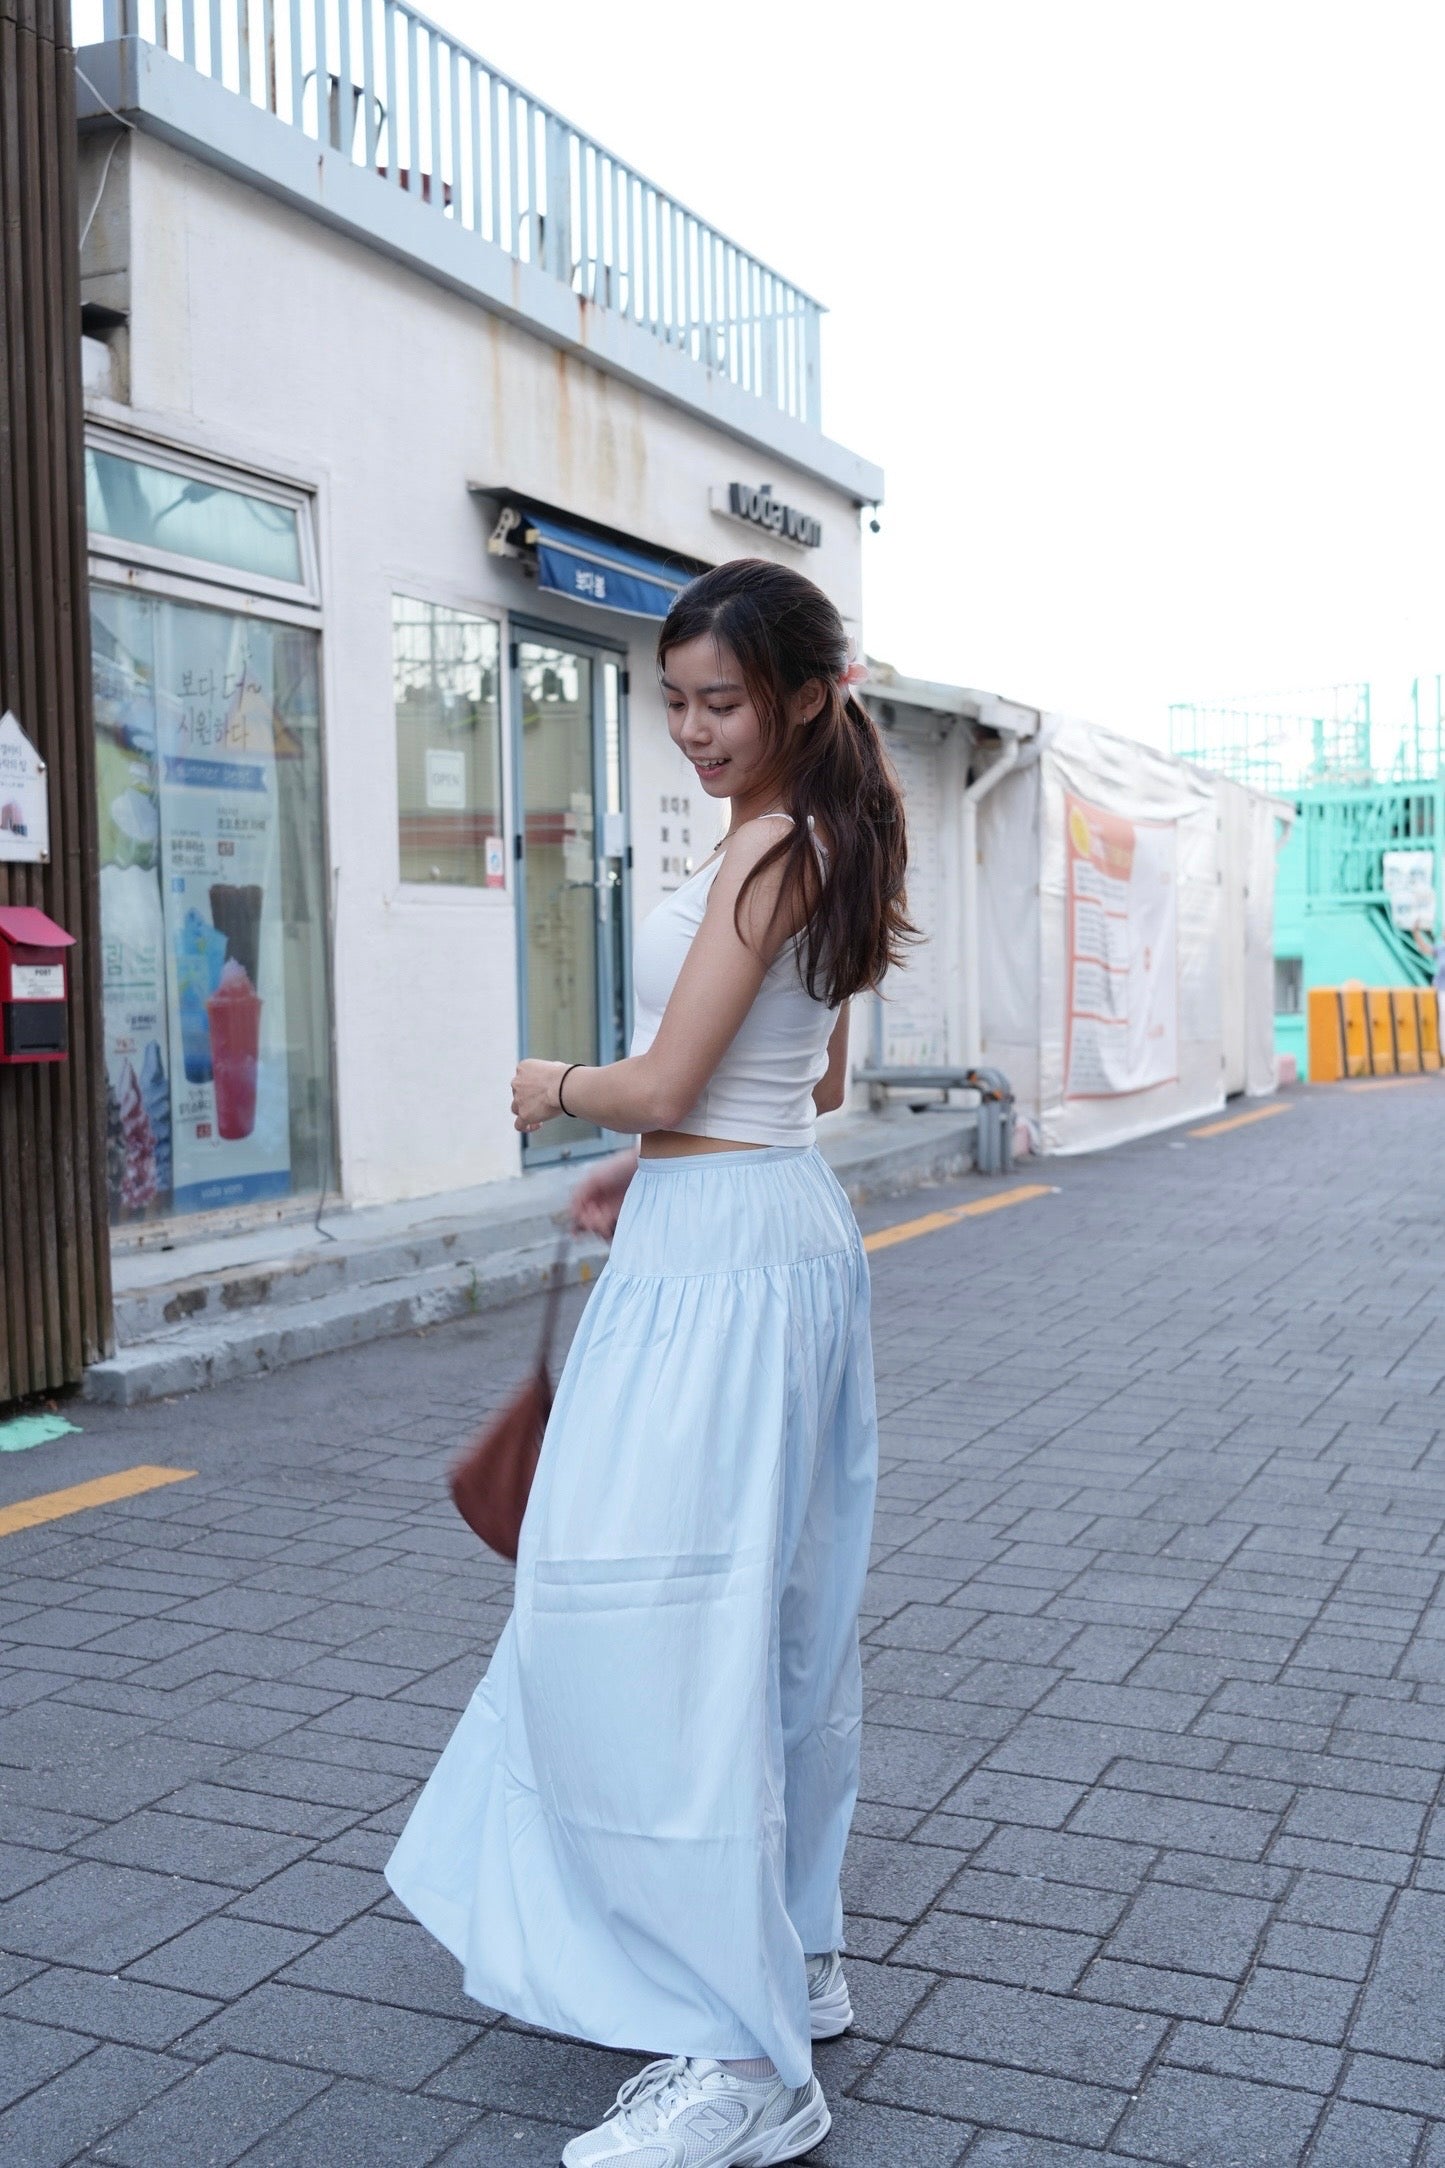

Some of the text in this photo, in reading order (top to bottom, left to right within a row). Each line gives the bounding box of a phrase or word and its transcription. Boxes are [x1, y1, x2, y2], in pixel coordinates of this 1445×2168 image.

[177, 669, 217, 704] 보다
[178, 706, 250, 752] 시원하다
[432, 773, 460, 786] OPEN
[687, 2105, 731, 2142] N
